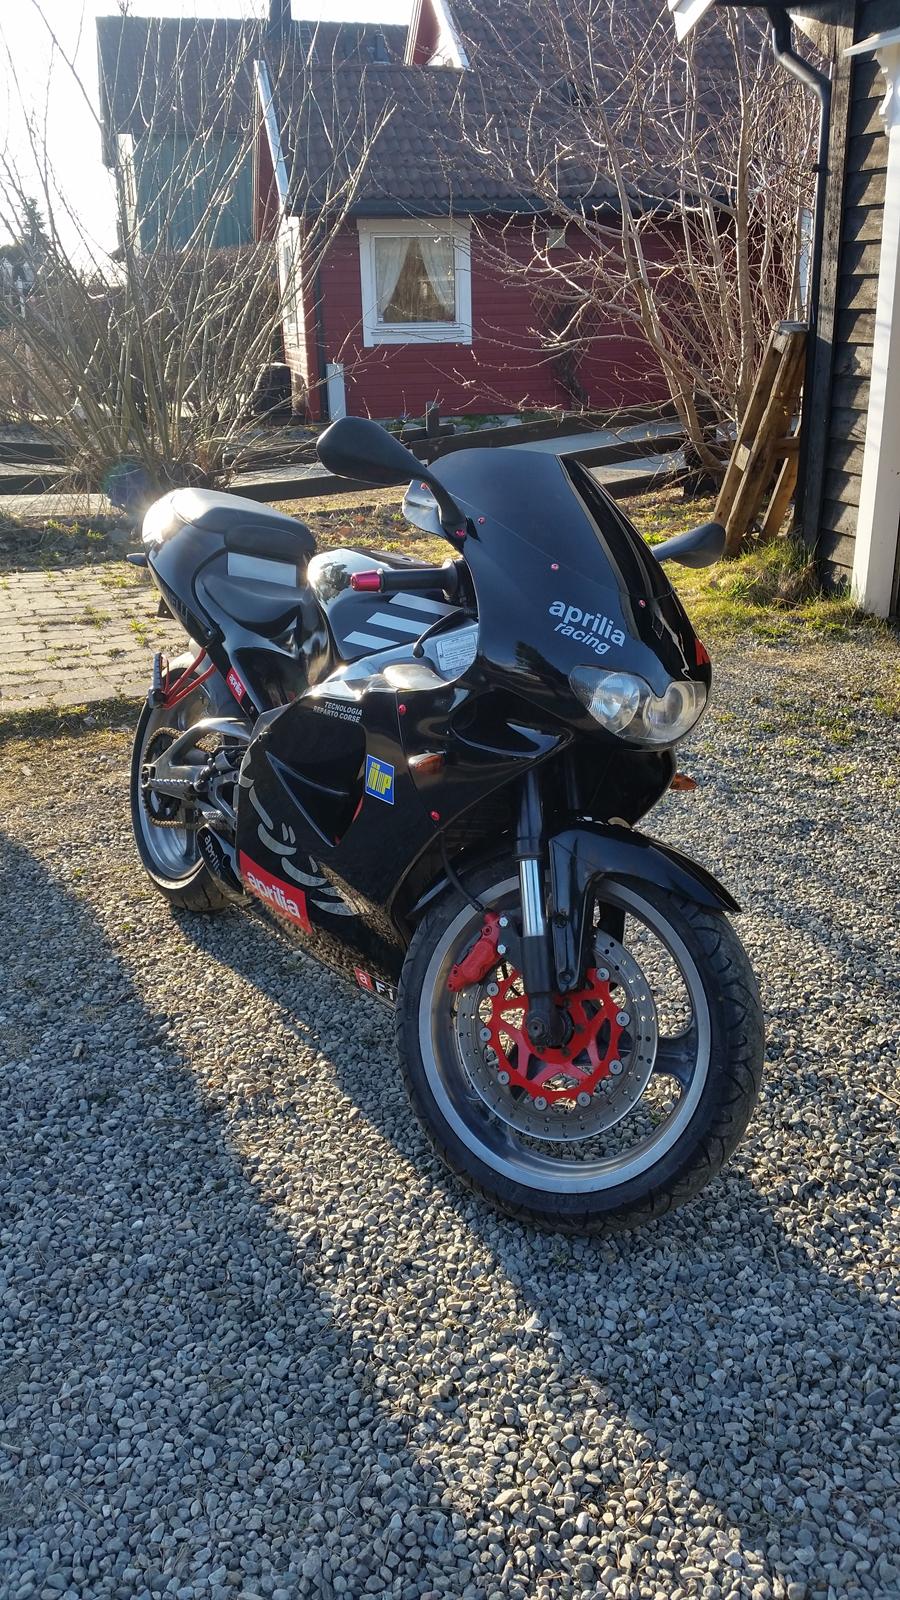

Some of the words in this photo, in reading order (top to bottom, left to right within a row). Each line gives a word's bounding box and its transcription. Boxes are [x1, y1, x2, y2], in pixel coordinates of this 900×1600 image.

[549, 600, 626, 647] aprilia
[554, 623, 611, 655] racing
[313, 705, 338, 718] REPARTO
[339, 712, 361, 723] CORSE
[324, 701, 363, 716] TECNOLOGIA
[247, 871, 301, 919] aprilia
